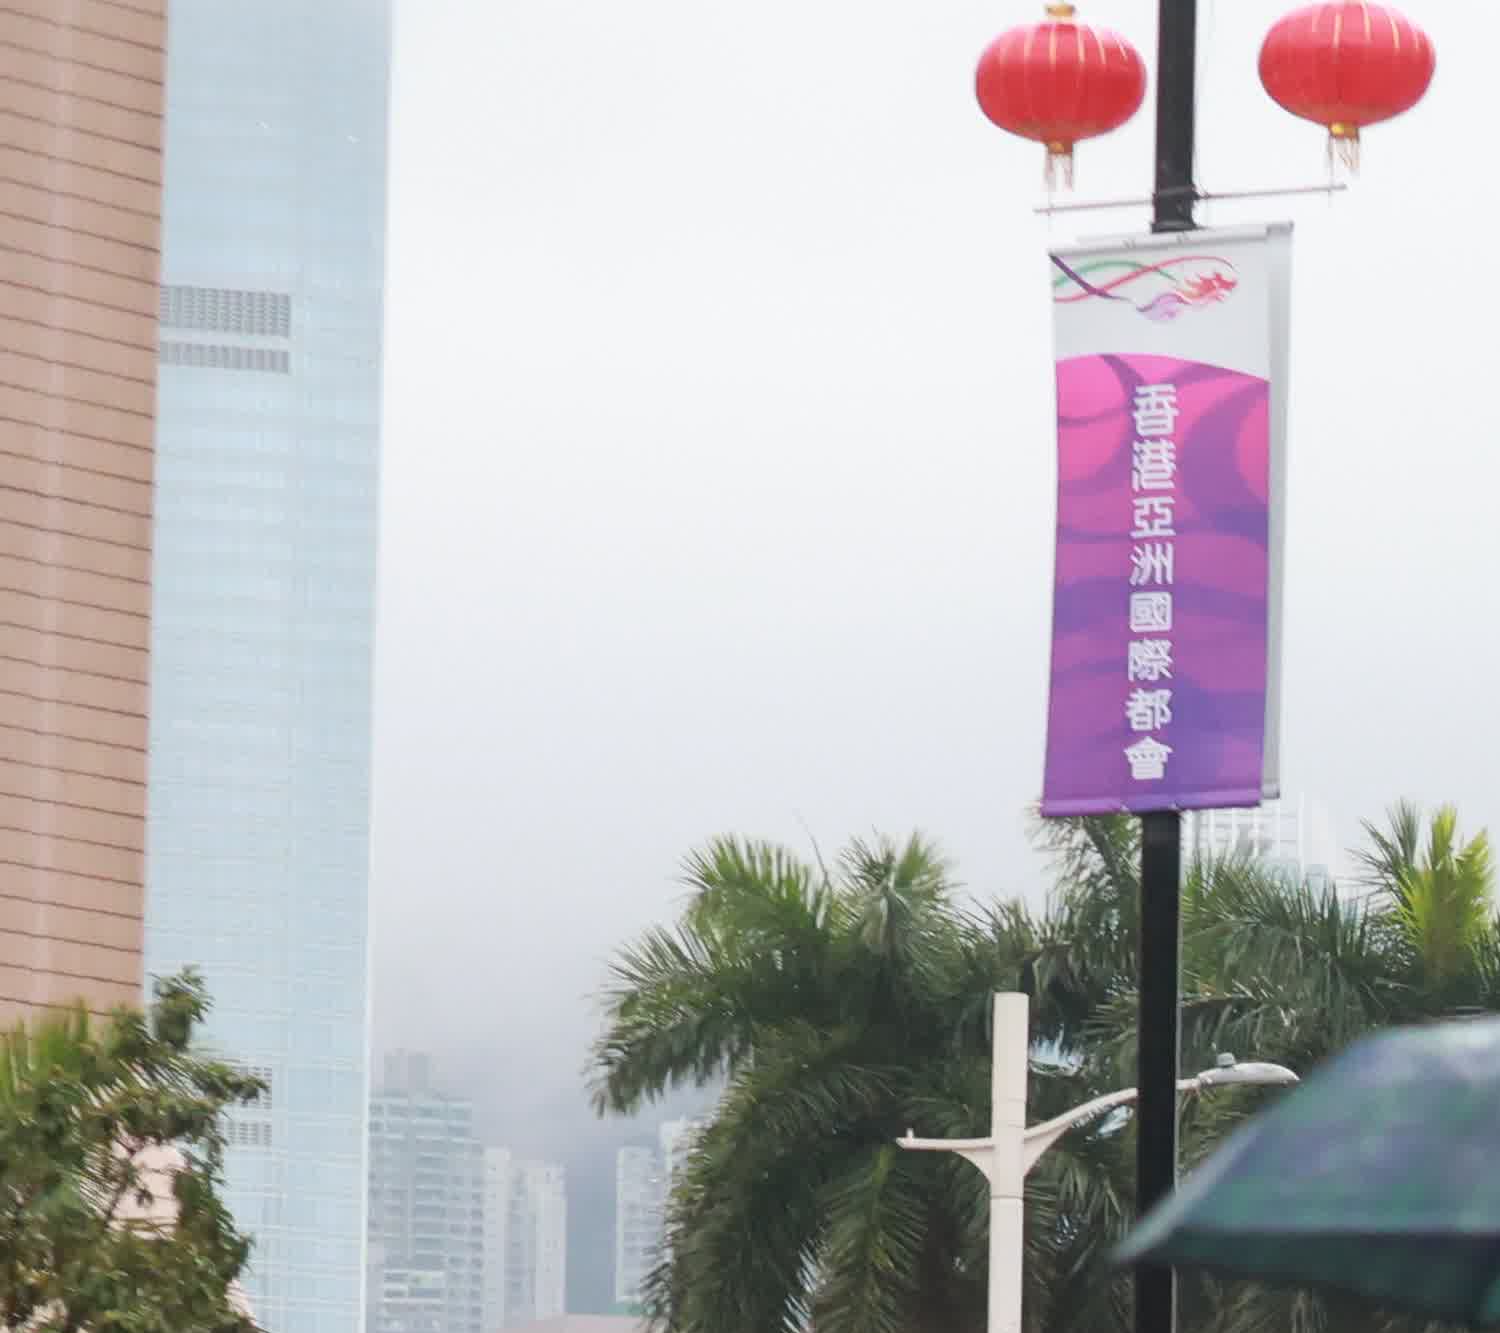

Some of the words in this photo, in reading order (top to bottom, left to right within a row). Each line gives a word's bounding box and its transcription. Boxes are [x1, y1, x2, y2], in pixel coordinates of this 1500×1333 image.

[1123, 384, 1180, 780] 香港亞洲國際都會
